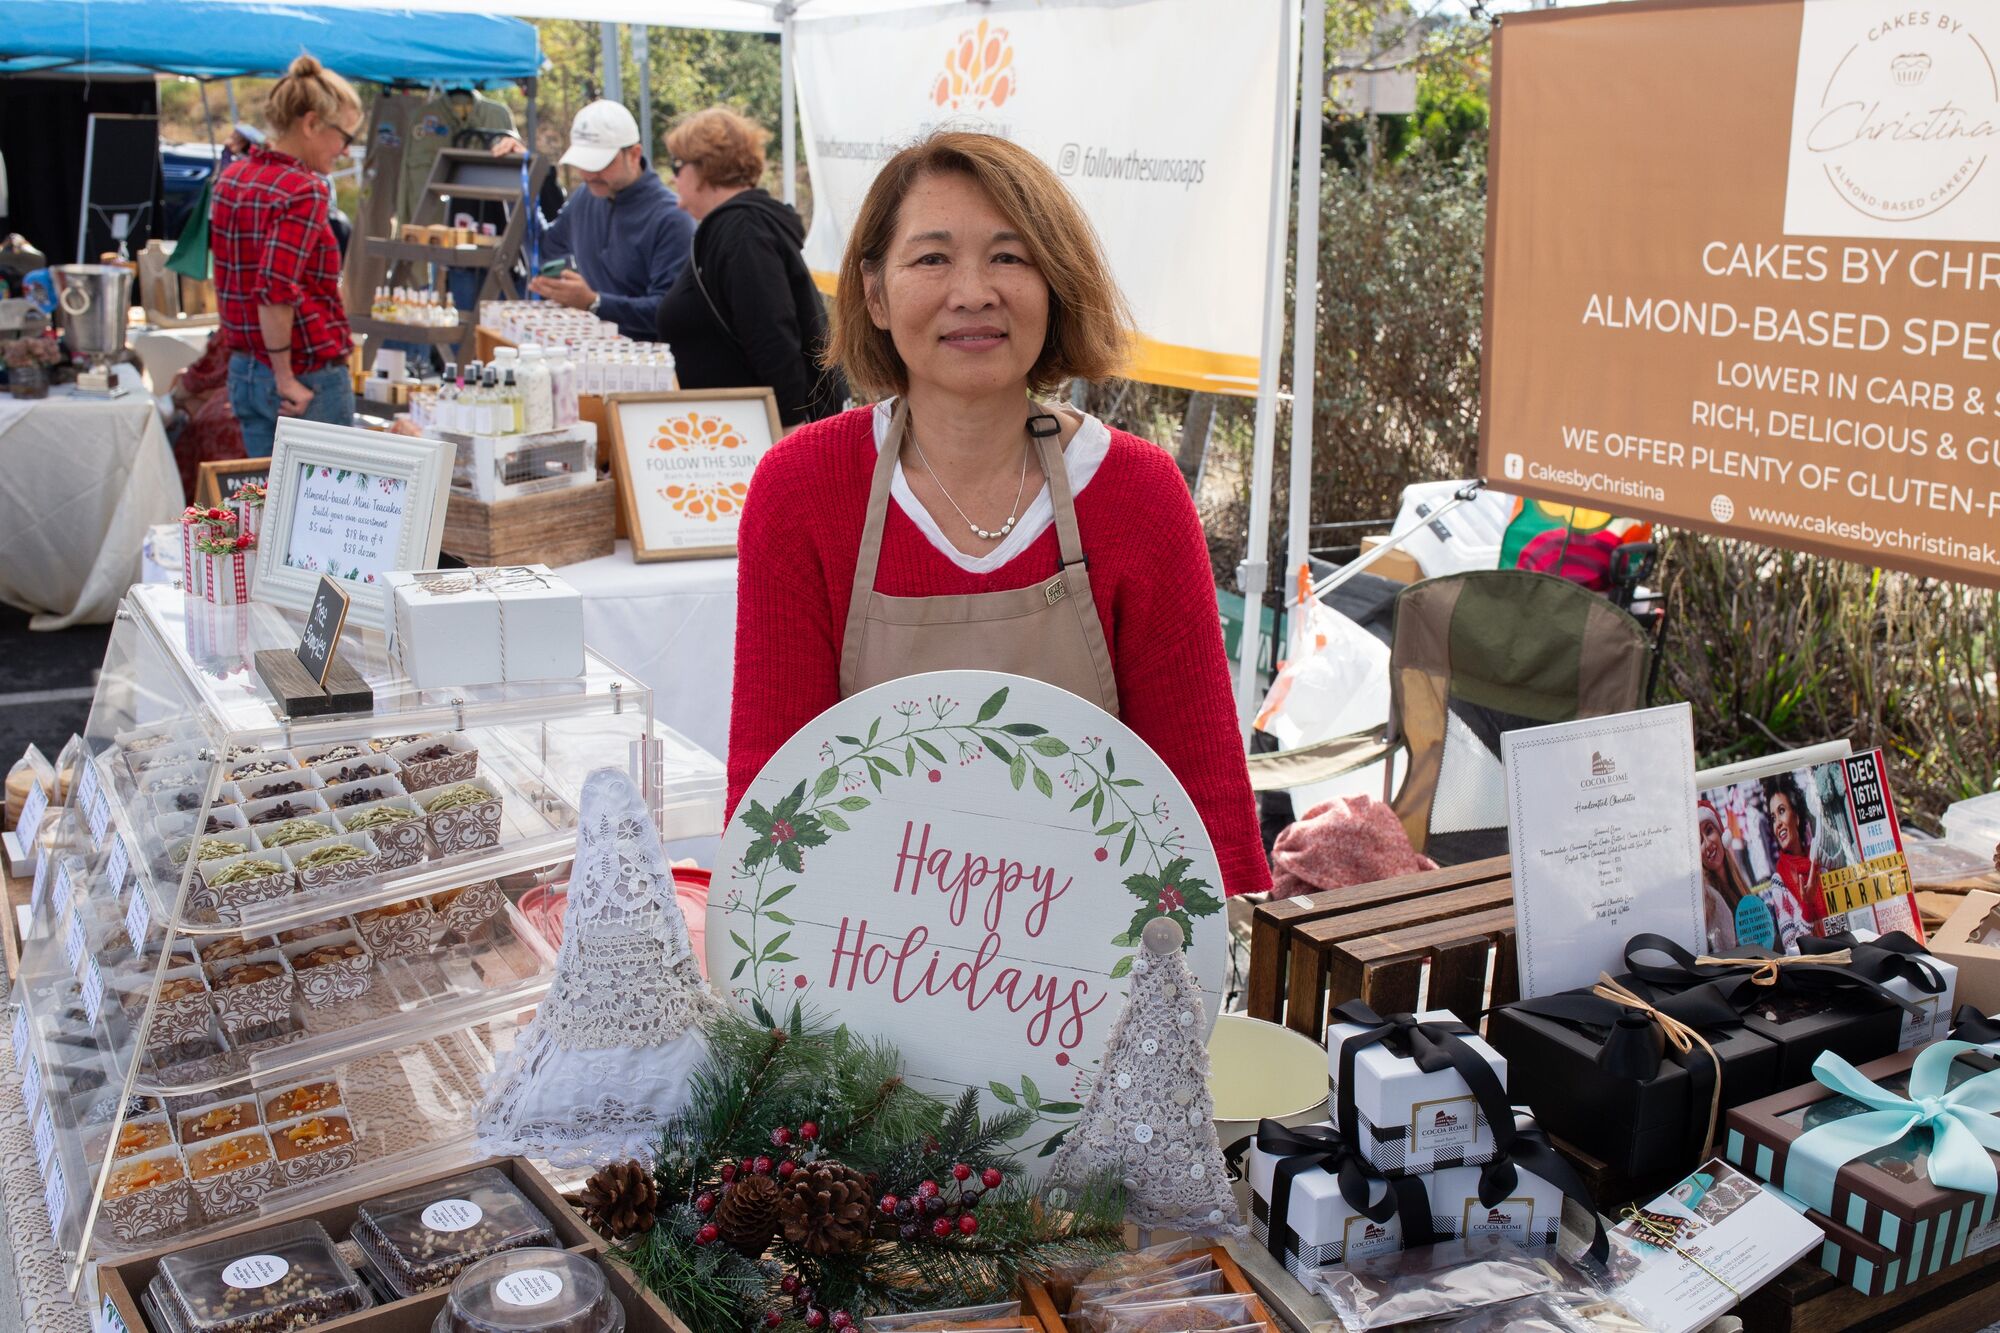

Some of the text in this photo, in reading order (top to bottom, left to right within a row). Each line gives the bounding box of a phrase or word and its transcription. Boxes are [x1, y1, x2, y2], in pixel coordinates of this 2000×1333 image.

[1868, 11, 1963, 41] CAKES BY
[1806, 100, 2000, 152] Christina
[1082, 146, 1206, 192] followthesunsoaps
[1835, 156, 1974, 212] ALMOND-BASED CAKERY
[1702, 241, 1828, 282] CAKES
[1842, 247, 1899, 285] BY
[1582, 294, 1891, 351] ALMOND-BASED
[1717, 360, 1819, 396] LOWER
[1828, 372, 1858, 400] IN
[1867, 377, 1954, 411] CARB
[1963, 387, 1984, 415] &
[1692, 400, 1760, 438] RICH,
[1768, 410, 1928, 456] DELICIOUS
[1936, 432, 1958, 461] &
[647, 454, 757, 471] FOLLOW THE SUN
[1561, 425, 1599, 454] WE
[1604, 433, 1685, 468] OFFER
[1692, 446, 1793, 485] PLENTY
[1799, 463, 1840, 492] OF
[1528, 462, 1665, 502] CakesbyChristina
[304, 487, 402, 515] Almond-based Mini Teacakes
[312, 505, 329, 516] Build
[330, 511, 344, 522] your
[358, 517, 388, 528] assortment
[308, 521, 318, 531] $5
[319, 525, 333, 535] each
[345, 528, 358, 540] $18
[358, 530, 369, 542] box
[370, 533, 378, 546] of
[343, 543, 376, 558] $38 dozen
[1580, 772, 1628, 788] COCOA ROME
[1850, 757, 1874, 784] DEC
[1853, 784, 1879, 805] 16TH
[1857, 804, 1883, 821] 12-8PM
[1867, 824, 1883, 837] FREE
[1863, 838, 1895, 857] ADMISSION
[893, 820, 1073, 938] Happy
[1826, 870, 1911, 915] MARKET
[829, 916, 1107, 1049] Holidays
[1422, 1124, 1469, 1136] COCOA ROME
[1352, 1235, 1394, 1249] COCOA ROME
